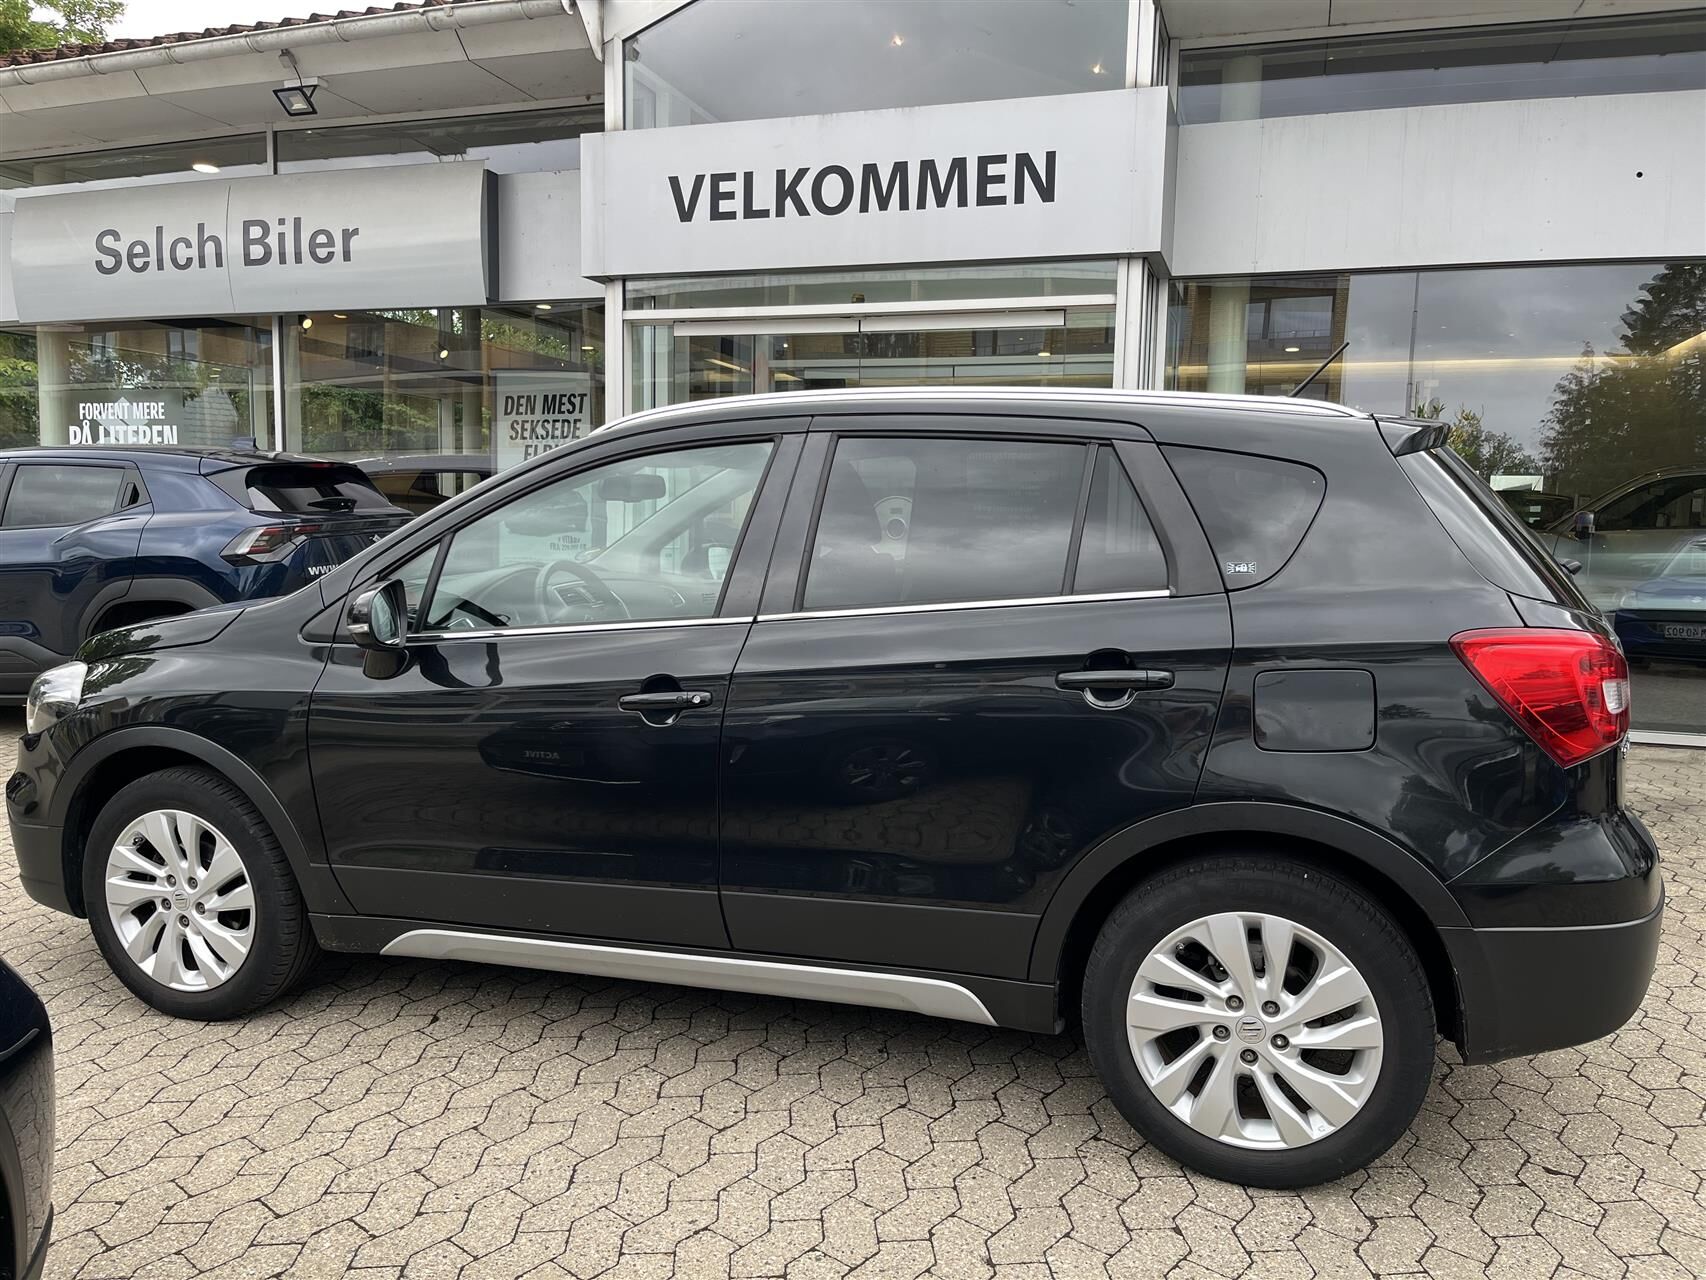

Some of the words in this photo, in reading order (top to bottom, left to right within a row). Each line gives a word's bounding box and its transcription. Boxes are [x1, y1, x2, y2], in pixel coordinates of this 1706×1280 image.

[667, 150, 1057, 223] VELKOMMEN
[95, 222, 224, 275] Selch
[242, 216, 360, 267] Biler
[79, 402, 130, 420] FORVENT
[132, 402, 166, 420] MERE
[503, 394, 537, 416] DEN
[541, 393, 588, 415] MEST
[509, 418, 583, 441] SEKSEDE
